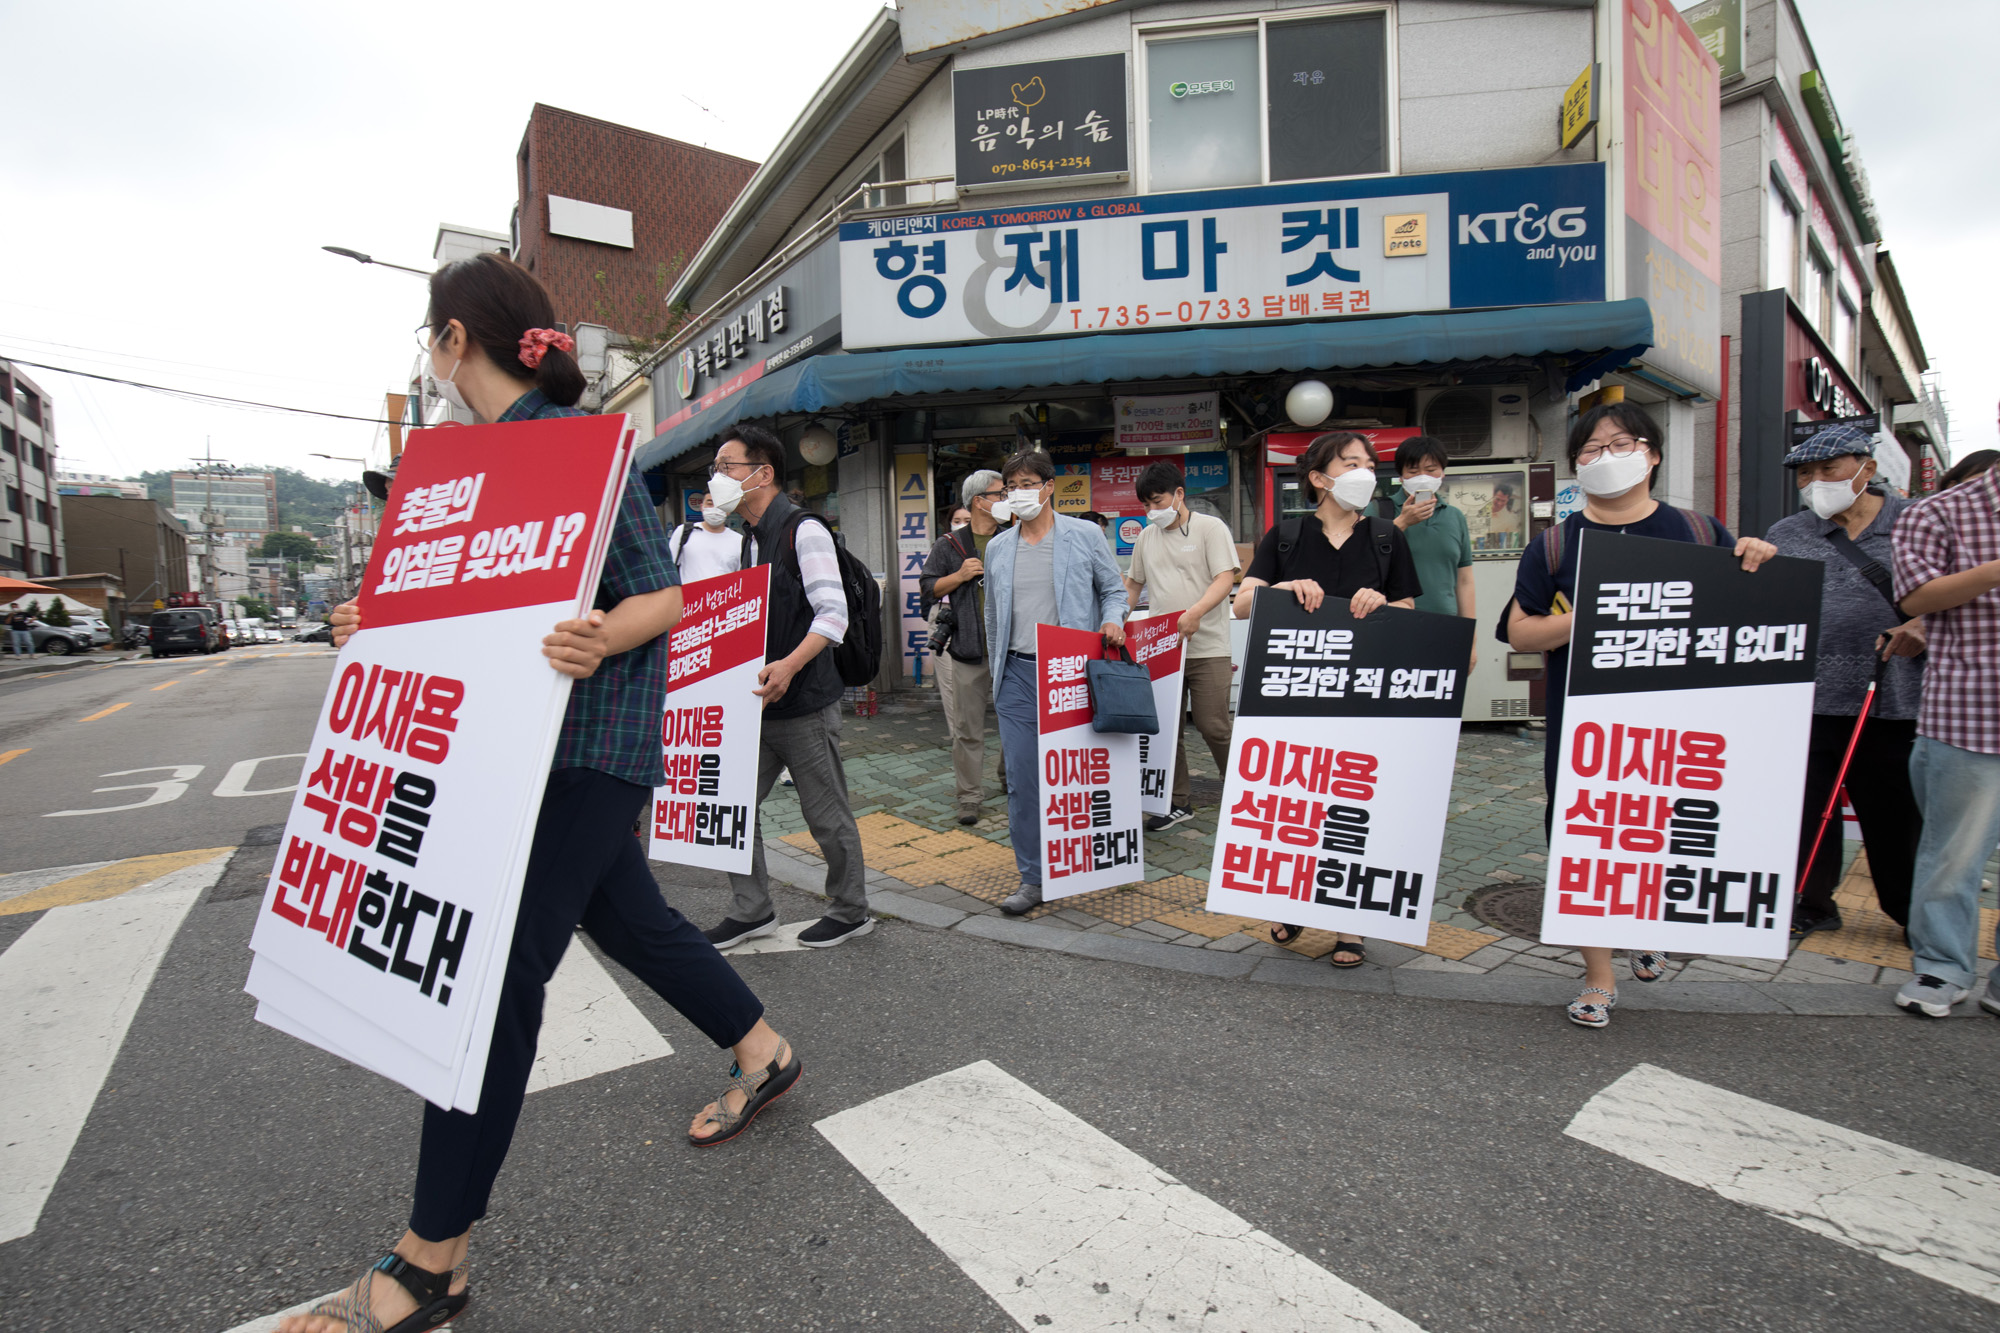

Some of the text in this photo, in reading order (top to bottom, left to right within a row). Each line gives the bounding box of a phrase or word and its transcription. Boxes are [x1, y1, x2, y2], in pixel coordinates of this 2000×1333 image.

[1189, 80, 1235, 95] 모두투어
[1293, 70, 1325, 85] 자유
[977, 106, 1019, 121] LP時代
[970, 116, 1064, 152] 음악의
[992, 155, 1091, 175] 070-8654-2254
[868, 216, 938, 237] 케이티앤지
[942, 203, 1144, 230] KOREA TOMORROW & GLOBAL
[1458, 203, 1586, 245] KT&G
[1390, 239, 1421, 251] proto
[1526, 244, 1596, 268] and you
[697, 285, 785, 377] 복권판매점
[1135, 421, 1164, 431] 700만
[1188, 400, 1212, 414] 출시!
[1202, 465, 1224, 476] 마켓
[393, 472, 487, 537] 촛불의
[1058, 498, 1086, 507] proto
[1121, 526, 1142, 538] 담배
[375, 512, 587, 596] 외침을 잊었나?
[900, 473, 929, 656] 스포츠토토
[680, 597, 703, 622] 대의
[1597, 580, 1694, 621] 국민은
[671, 596, 762, 653] 국정농단 노동탄압
[1267, 628, 1354, 660] 국민은
[668, 645, 712, 682] 회계조작
[1591, 623, 1807, 669] 공감한 적 없다!
[1047, 654, 1088, 684] 촛불의
[1260, 666, 1457, 700] 공감한 적 없다!
[329, 661, 466, 766] 이재용
[1048, 684, 1089, 715] 외침을
[662, 705, 724, 748] 이재용
[1045, 747, 1111, 787] 이재용
[1238, 737, 1379, 802] 이재용
[1571, 721, 1727, 792] 이재용
[303, 747, 437, 868] 석방을
[655, 799, 747, 850] 반대한다!
[1046, 789, 1112, 832] 석방을
[1230, 790, 1370, 856] 석방을
[1565, 788, 1720, 858] 석방을
[1047, 828, 1138, 880] 반대한다!
[1221, 842, 1424, 920] 반대한다!
[1558, 856, 1780, 930] 반대한다!
[271, 834, 474, 1008] 반대한다!
